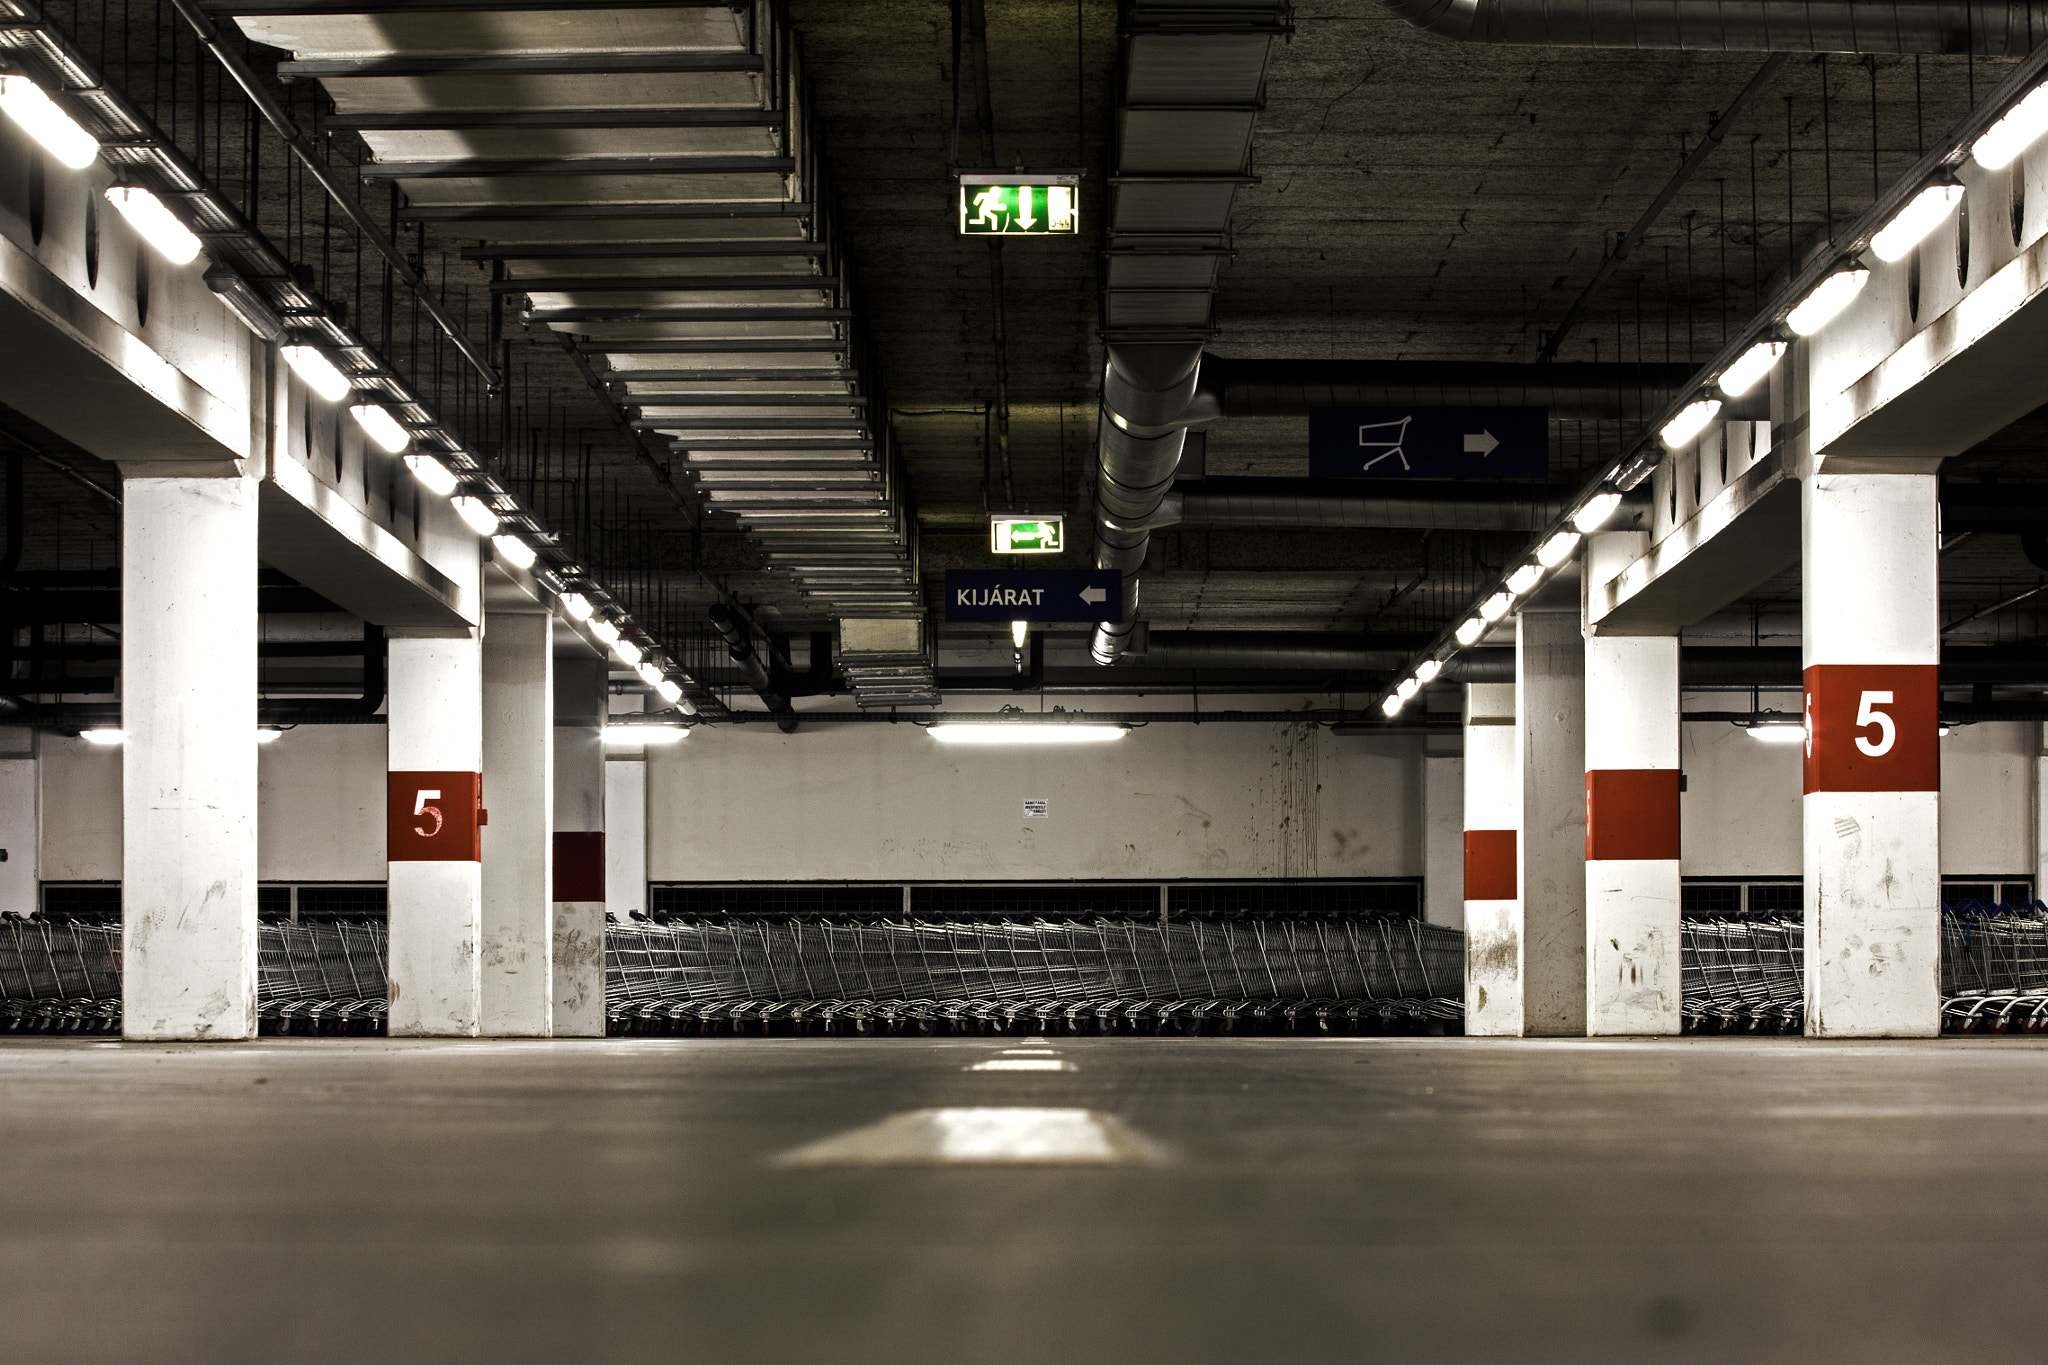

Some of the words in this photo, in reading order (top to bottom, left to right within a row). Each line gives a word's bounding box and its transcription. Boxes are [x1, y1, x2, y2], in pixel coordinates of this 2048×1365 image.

[956, 584, 1045, 606] KIJÁRAT
[1854, 690, 1896, 757] 5
[413, 789, 443, 837] 5
